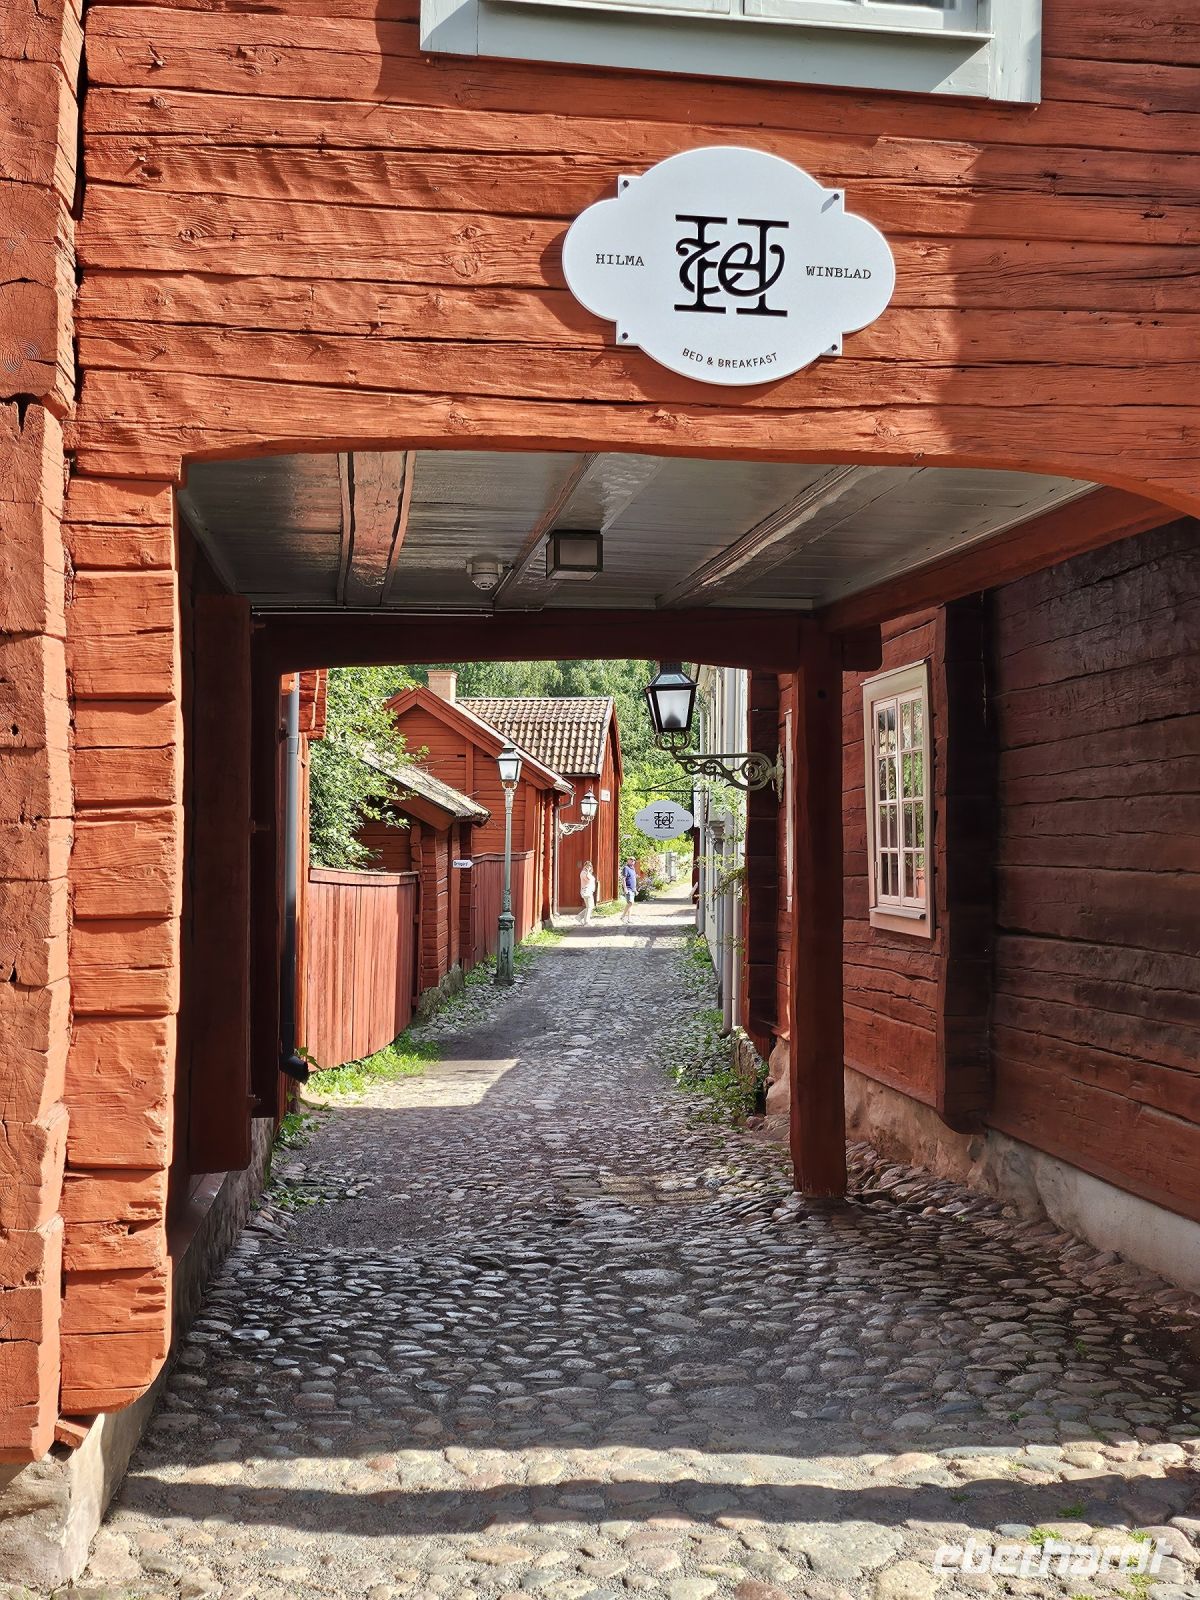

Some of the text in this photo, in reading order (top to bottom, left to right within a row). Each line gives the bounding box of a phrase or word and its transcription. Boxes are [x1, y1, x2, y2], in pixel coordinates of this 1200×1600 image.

[595, 253, 872, 280] HILMA WINBLAD
[682, 347, 778, 369] BED & BREAKFAST
